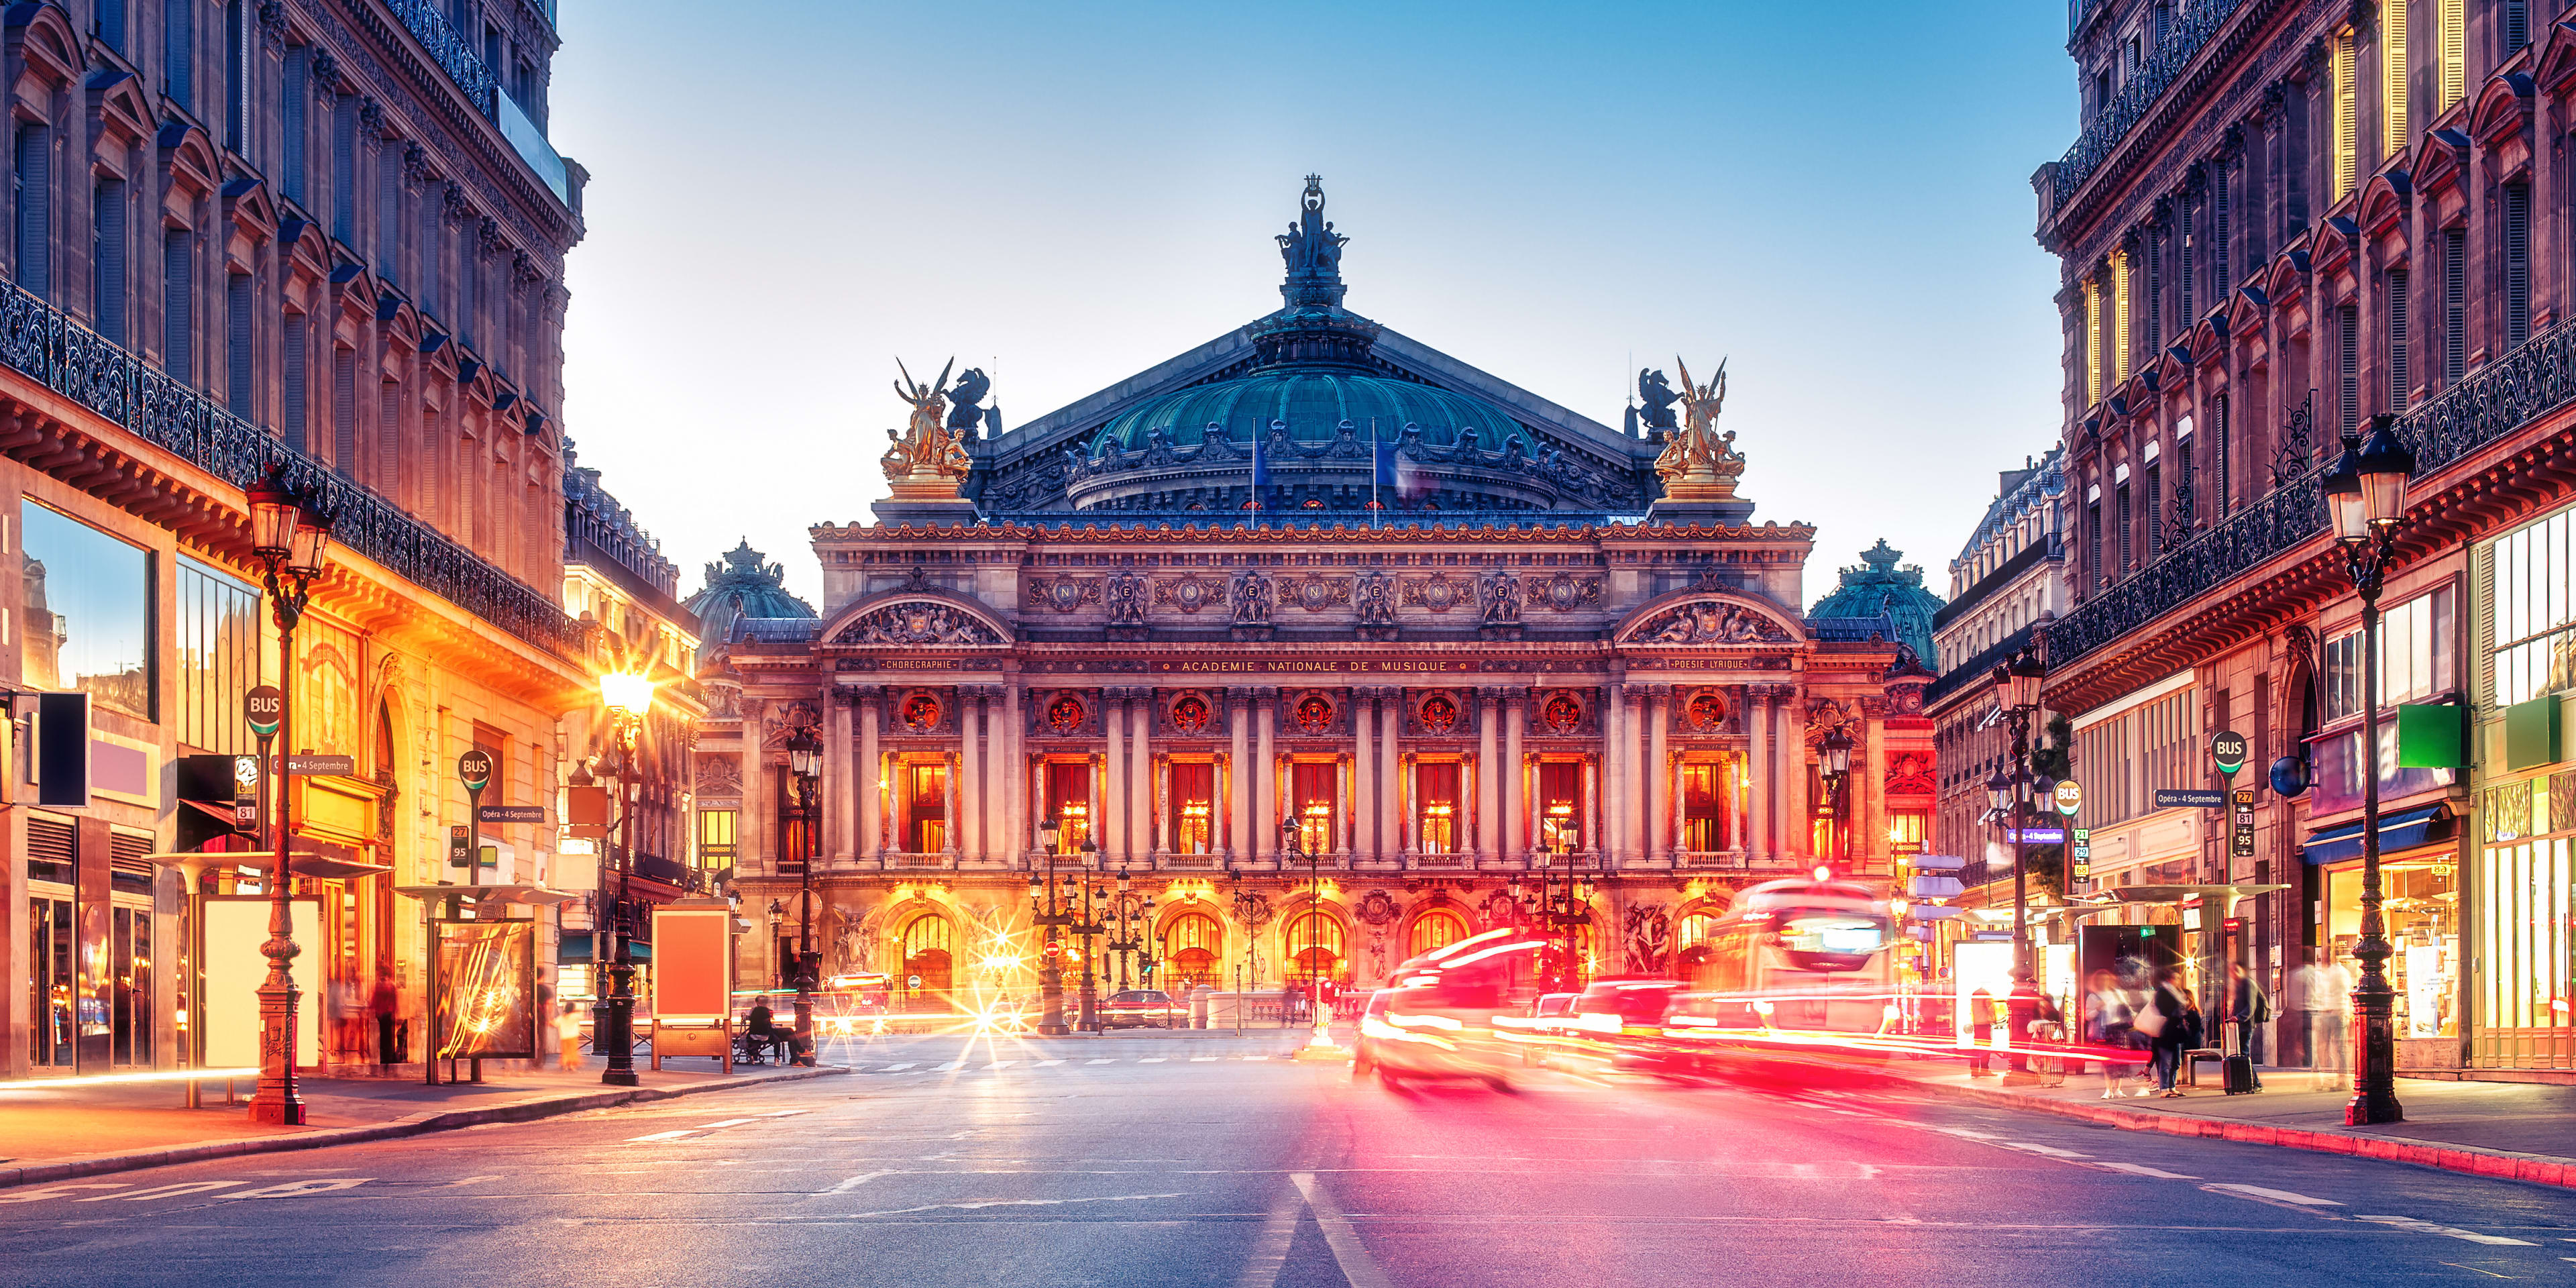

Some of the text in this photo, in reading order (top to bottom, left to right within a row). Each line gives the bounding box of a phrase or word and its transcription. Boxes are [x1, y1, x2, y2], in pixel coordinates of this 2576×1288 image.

[1061, 588, 1069, 598] N
[1124, 588, 1130, 596] E
[1186, 588, 1194, 596] N
[1310, 588, 1318, 596] N
[1373, 588, 1379, 596] E
[1434, 588, 1442, 596] N
[1559, 588, 1566, 596] N
[1182, 661, 1447, 671] ACADEMIE NATIONALE DE MUSIQUE
[1674, 659, 1744, 668] POESIE LYRIQUE
[250, 697, 279, 712] BUS
[2216, 741, 2243, 755] BUS
[274, 760, 297, 769] Ora
[309, 761, 348, 771] Septembre
[463, 760, 487, 772] BUS
[2057, 788, 2080, 800] BUS
[2239, 793, 2251, 802] 27
[2158, 794, 2177, 803] Opéra
[2188, 795, 2221, 804] Septembre
[240, 808, 253, 818] 81
[482, 810, 500, 818] Opéra
[510, 810, 542, 819] Septembre
[2239, 814, 2250, 823] 81
[454, 828, 466, 837] 27
[2239, 836, 2251, 845] 95
[453, 848, 466, 857] 95
